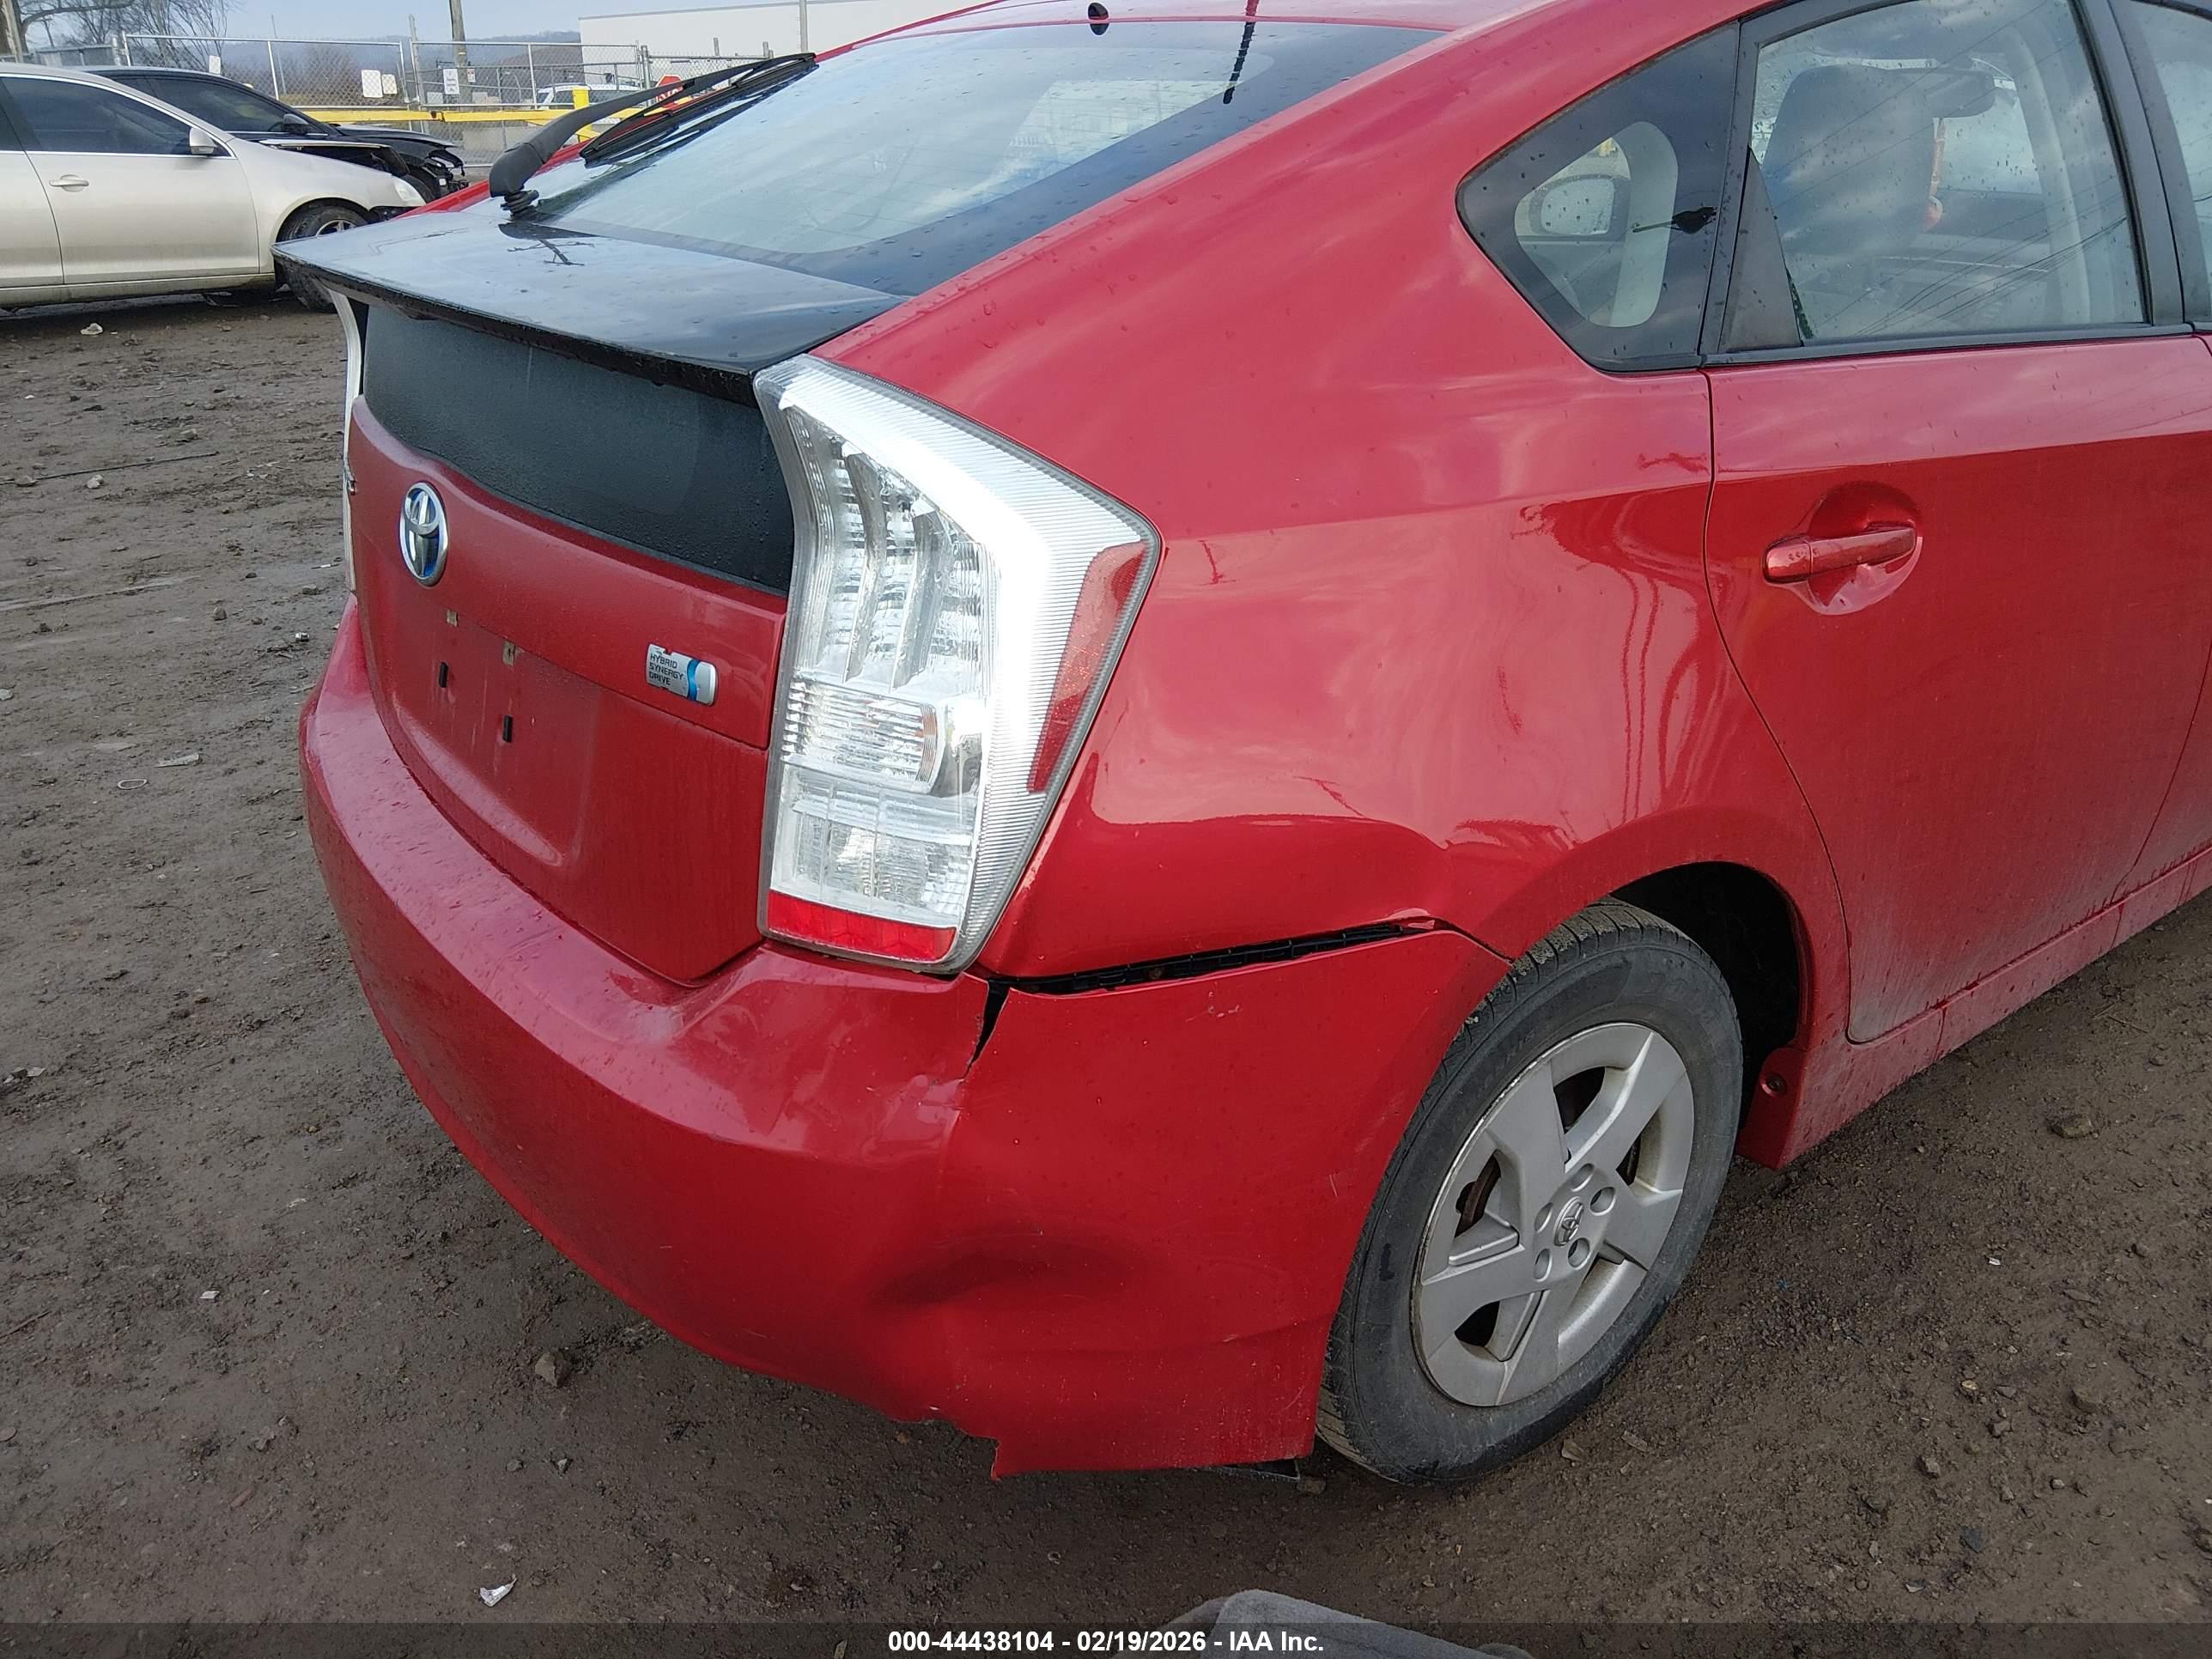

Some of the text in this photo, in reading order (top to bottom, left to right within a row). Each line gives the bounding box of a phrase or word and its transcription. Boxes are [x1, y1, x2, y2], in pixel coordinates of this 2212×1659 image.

[650, 653, 678, 669] HYBRID
[648, 671, 672, 685] DRIVE
[649, 662, 684, 680] SYNERGY
